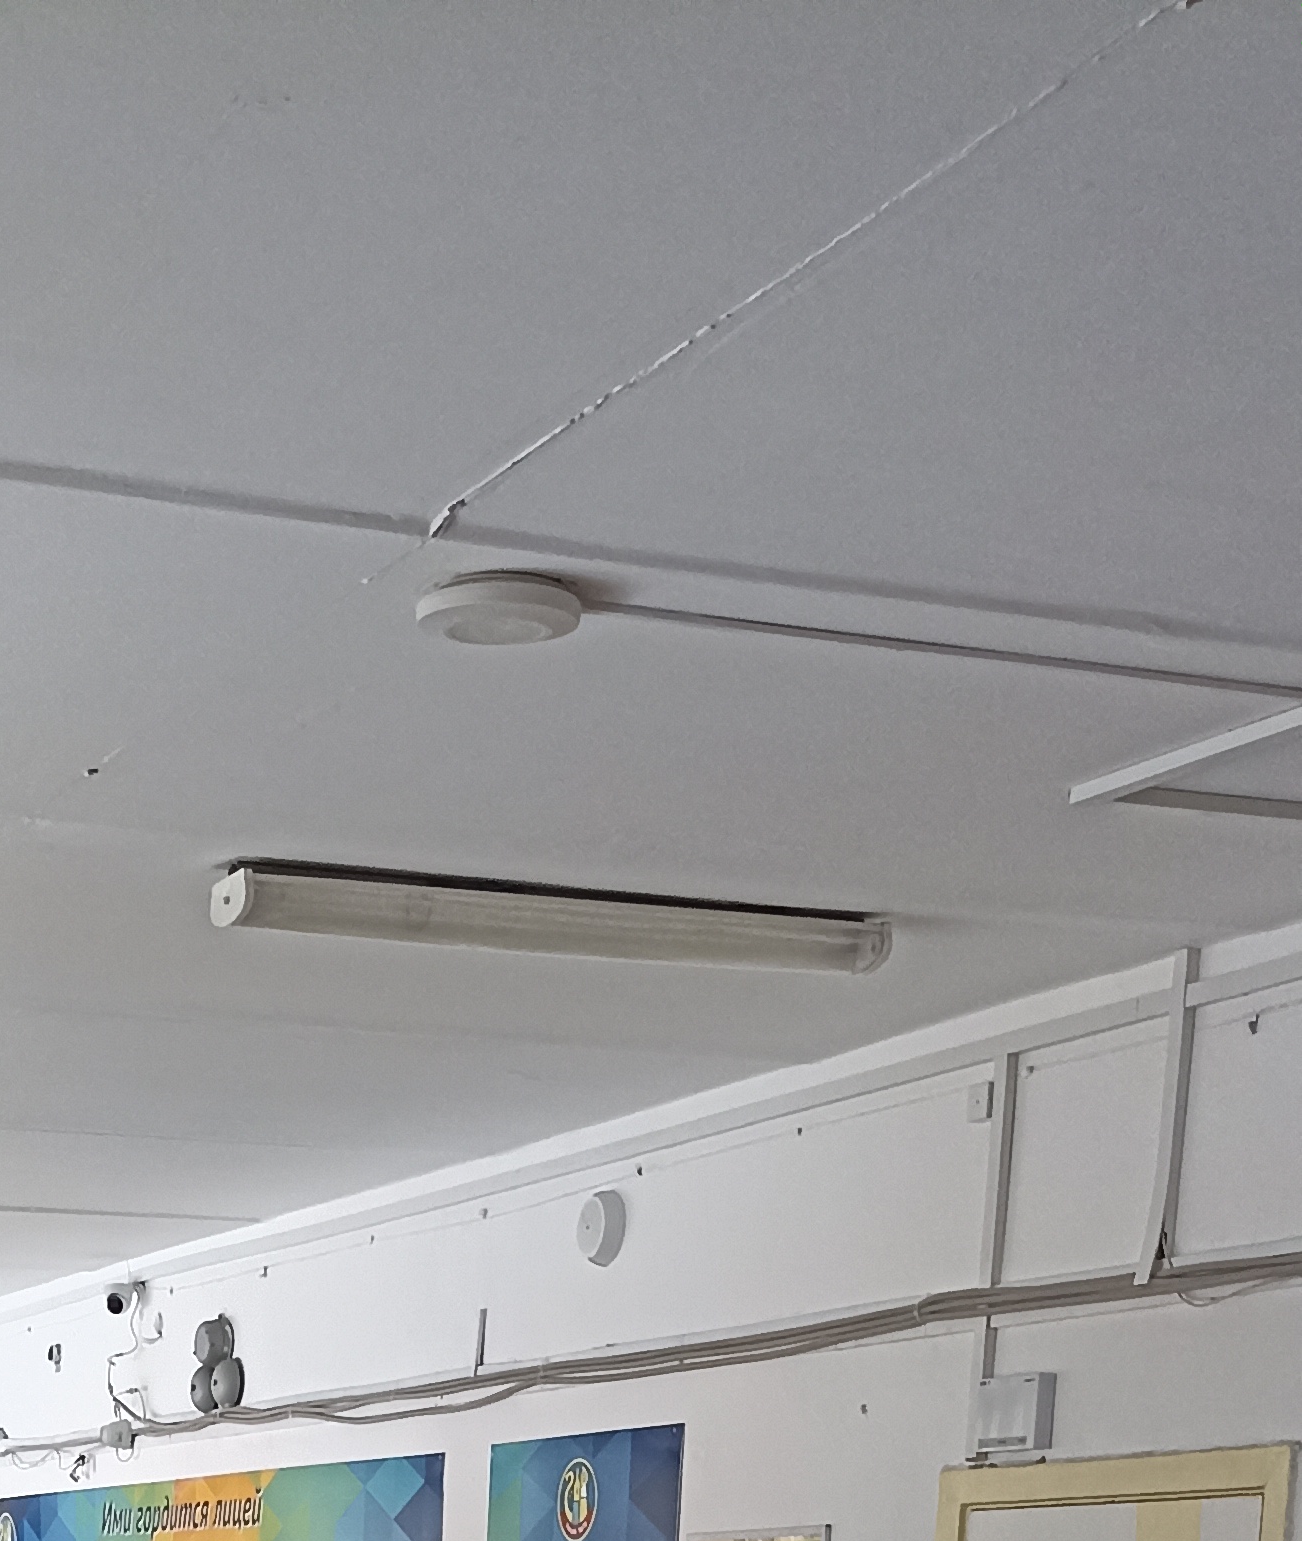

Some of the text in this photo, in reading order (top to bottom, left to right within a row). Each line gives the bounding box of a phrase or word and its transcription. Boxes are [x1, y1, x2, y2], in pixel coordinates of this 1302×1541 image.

[101, 1487, 263, 1541] Ими гордится лицей
